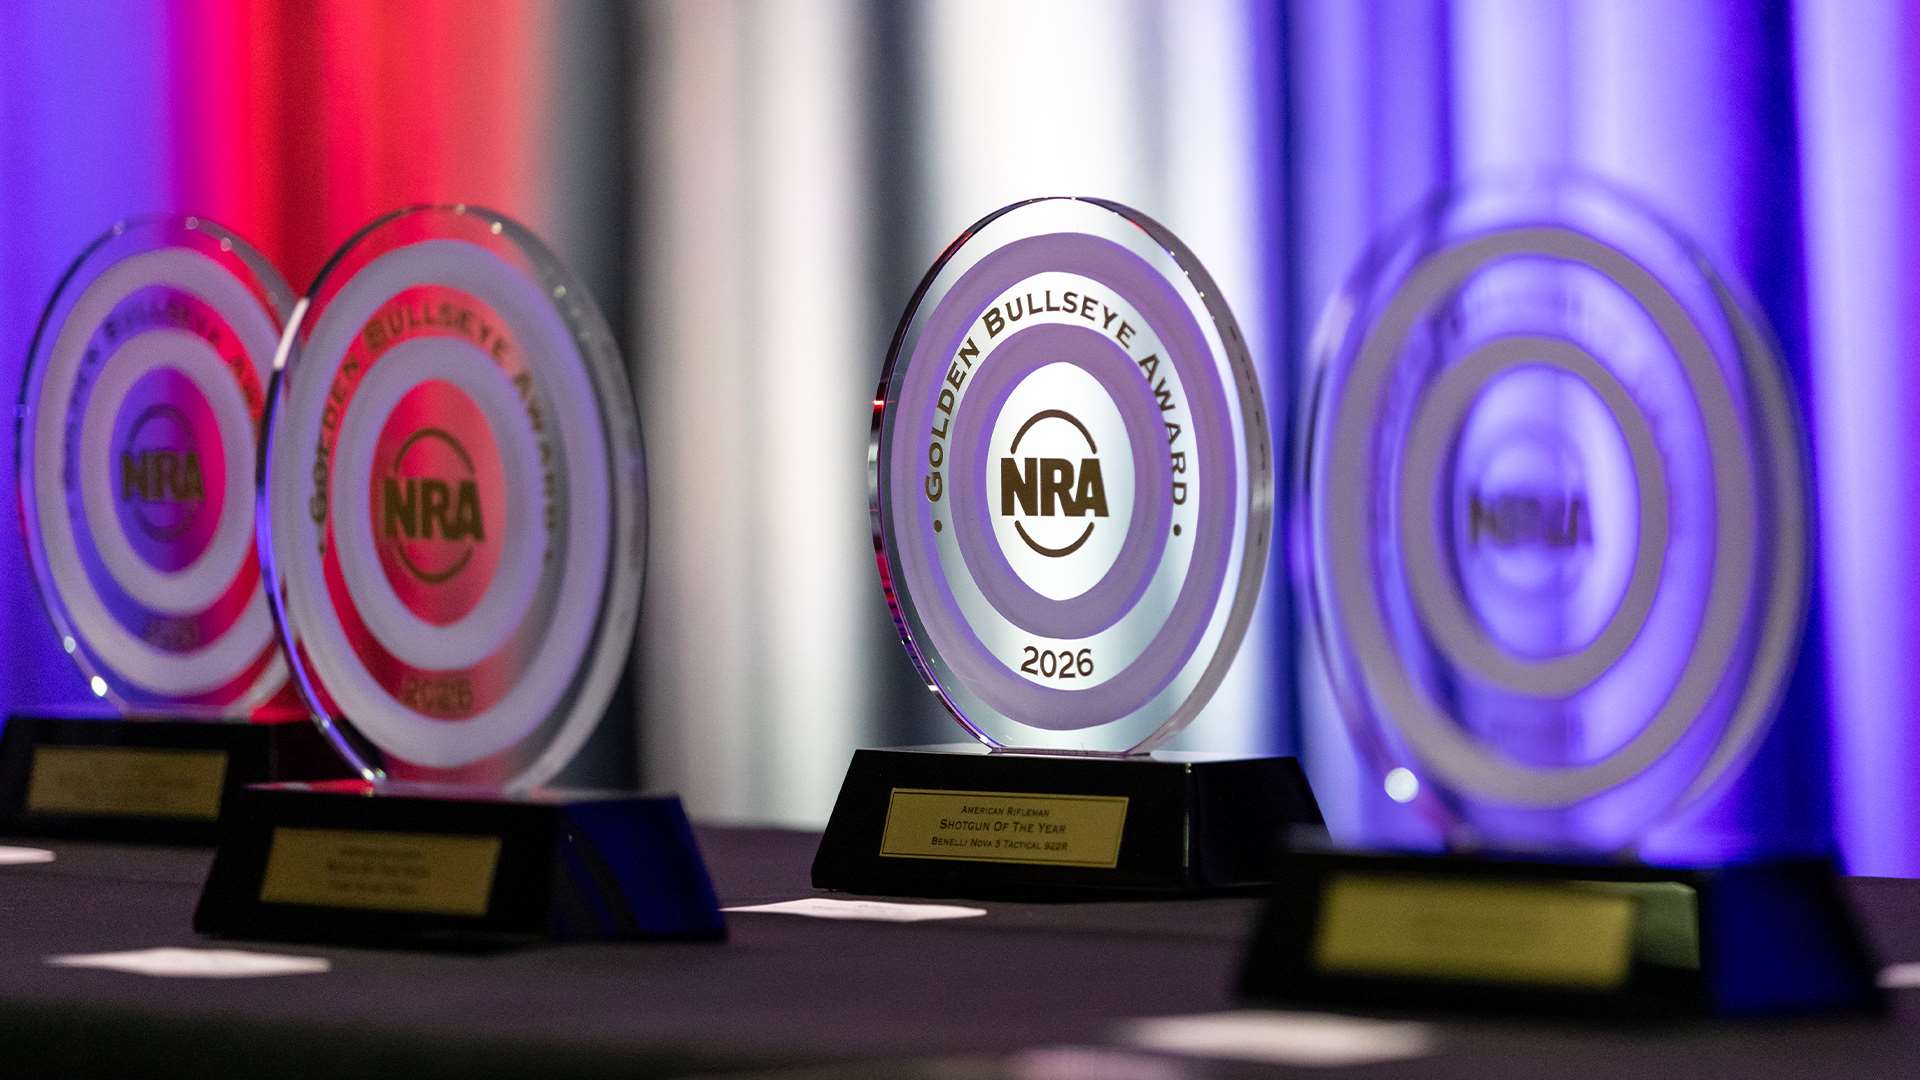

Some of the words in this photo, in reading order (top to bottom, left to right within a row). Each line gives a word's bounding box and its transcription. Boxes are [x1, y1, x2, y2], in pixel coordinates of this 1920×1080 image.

[925, 338, 981, 502] GOLDEN
[982, 290, 1137, 349] BULLSEYE
[1139, 353, 1188, 506] AWARD
[122, 451, 205, 502] NRA
[1001, 457, 1110, 517] NRA
[383, 478, 485, 541] NRA
[1020, 645, 1094, 678] 2026
[940, 818, 990, 832] SHOTGUN
[993, 821, 1009, 832] OF
[1013, 821, 1034, 833] THE
[1038, 823, 1067, 834] YEAR
[961, 805, 1004, 815] AMERICAN
[1007, 806, 1050, 817] RIFLEMAN
[931, 836, 968, 847] BENELLI
[970, 838, 993, 848] NOVA
[1004, 839, 1041, 850] TACTICAL
